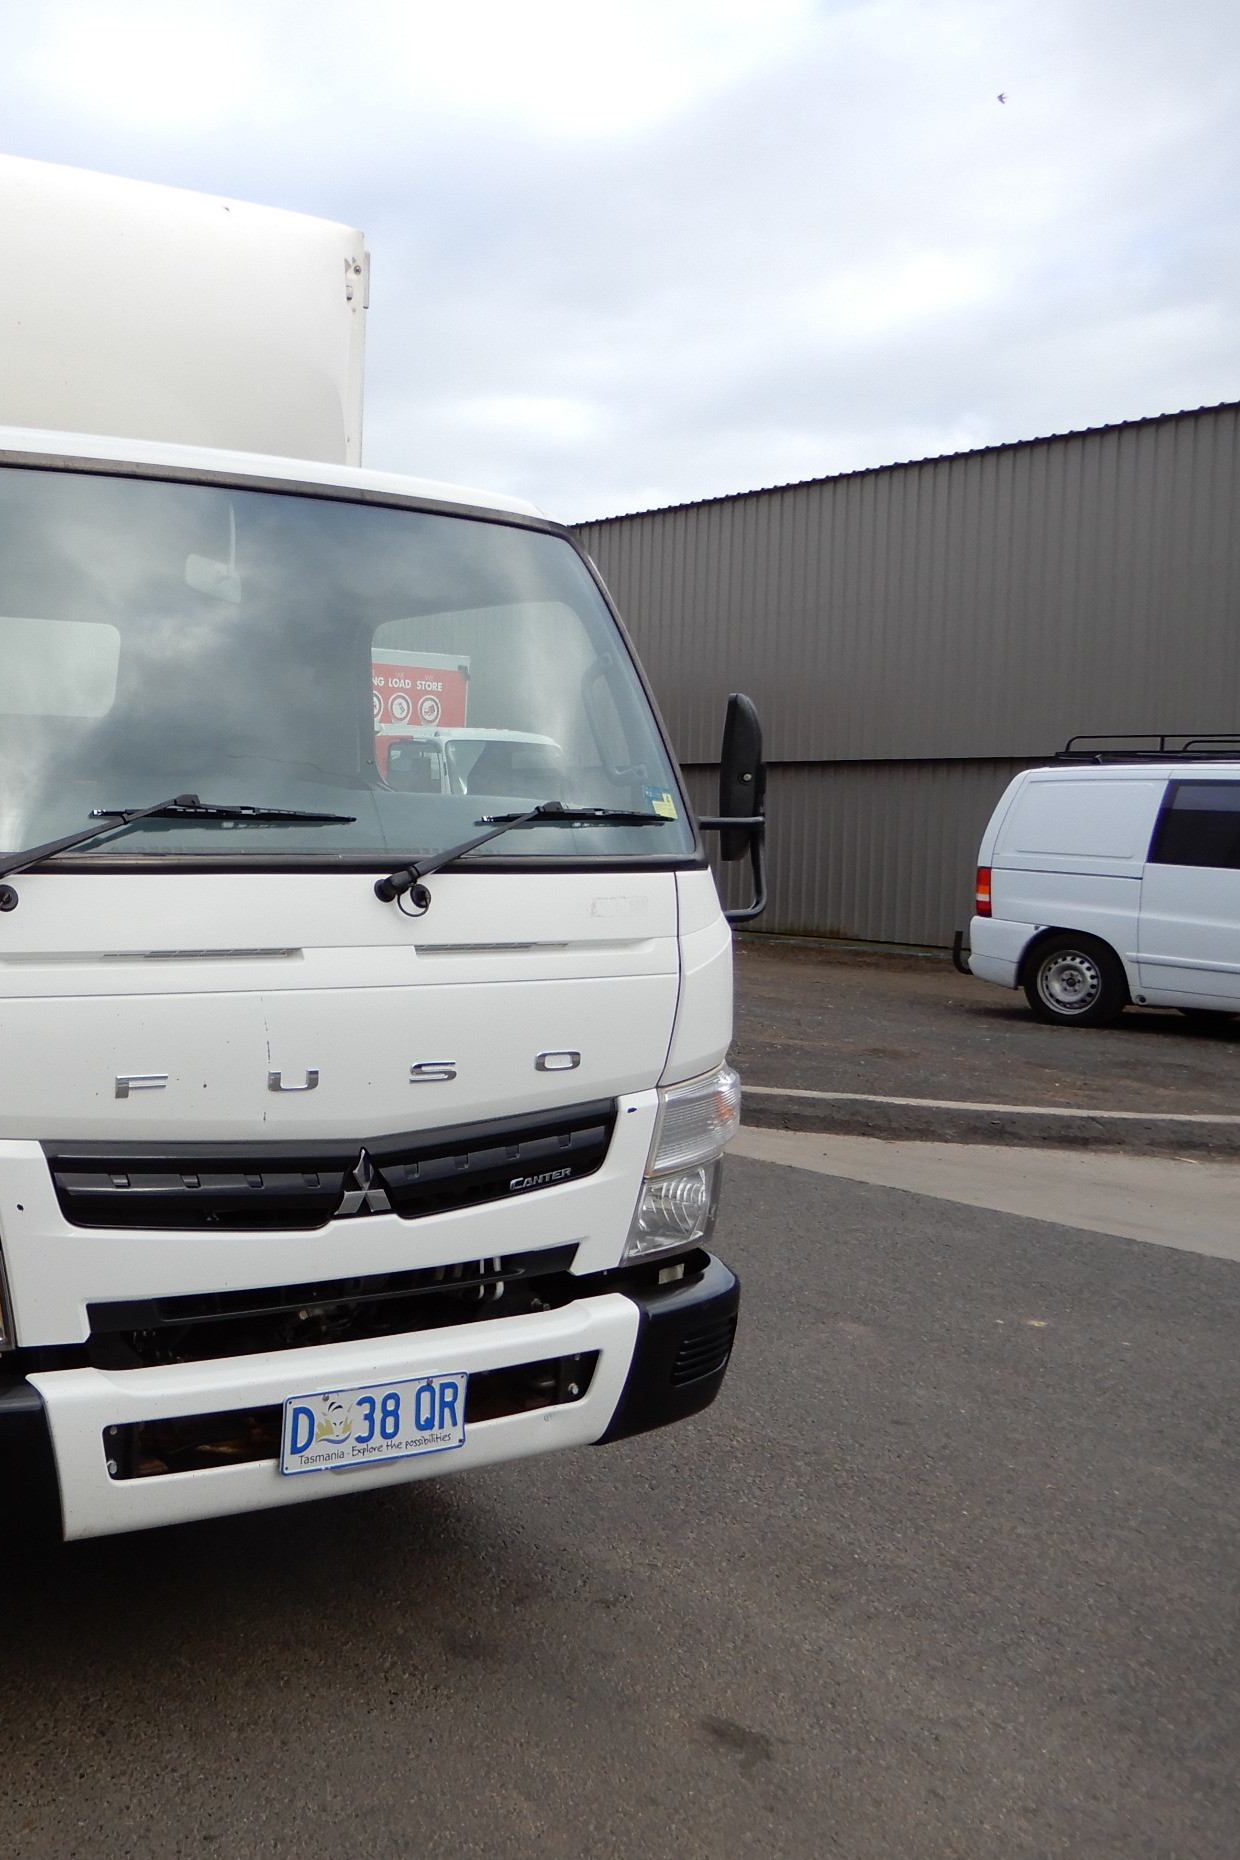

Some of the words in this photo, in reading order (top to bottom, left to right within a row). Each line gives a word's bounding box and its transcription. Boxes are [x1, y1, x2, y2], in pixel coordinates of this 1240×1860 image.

[389, 678, 412, 688] LOAD
[417, 681, 443, 691] STORE
[115, 1050, 582, 1099] FUSO
[510, 1166, 572, 1191] CANTER
[290, 1406, 315, 1455] D
[354, 1392, 401, 1444] 38
[415, 1381, 459, 1432] QR
[298, 1451, 345, 1466] Tasmania
[352, 1443, 384, 1457] Explore
[385, 1440, 403, 1450] the
[405, 1432, 451, 1450] possibilities
